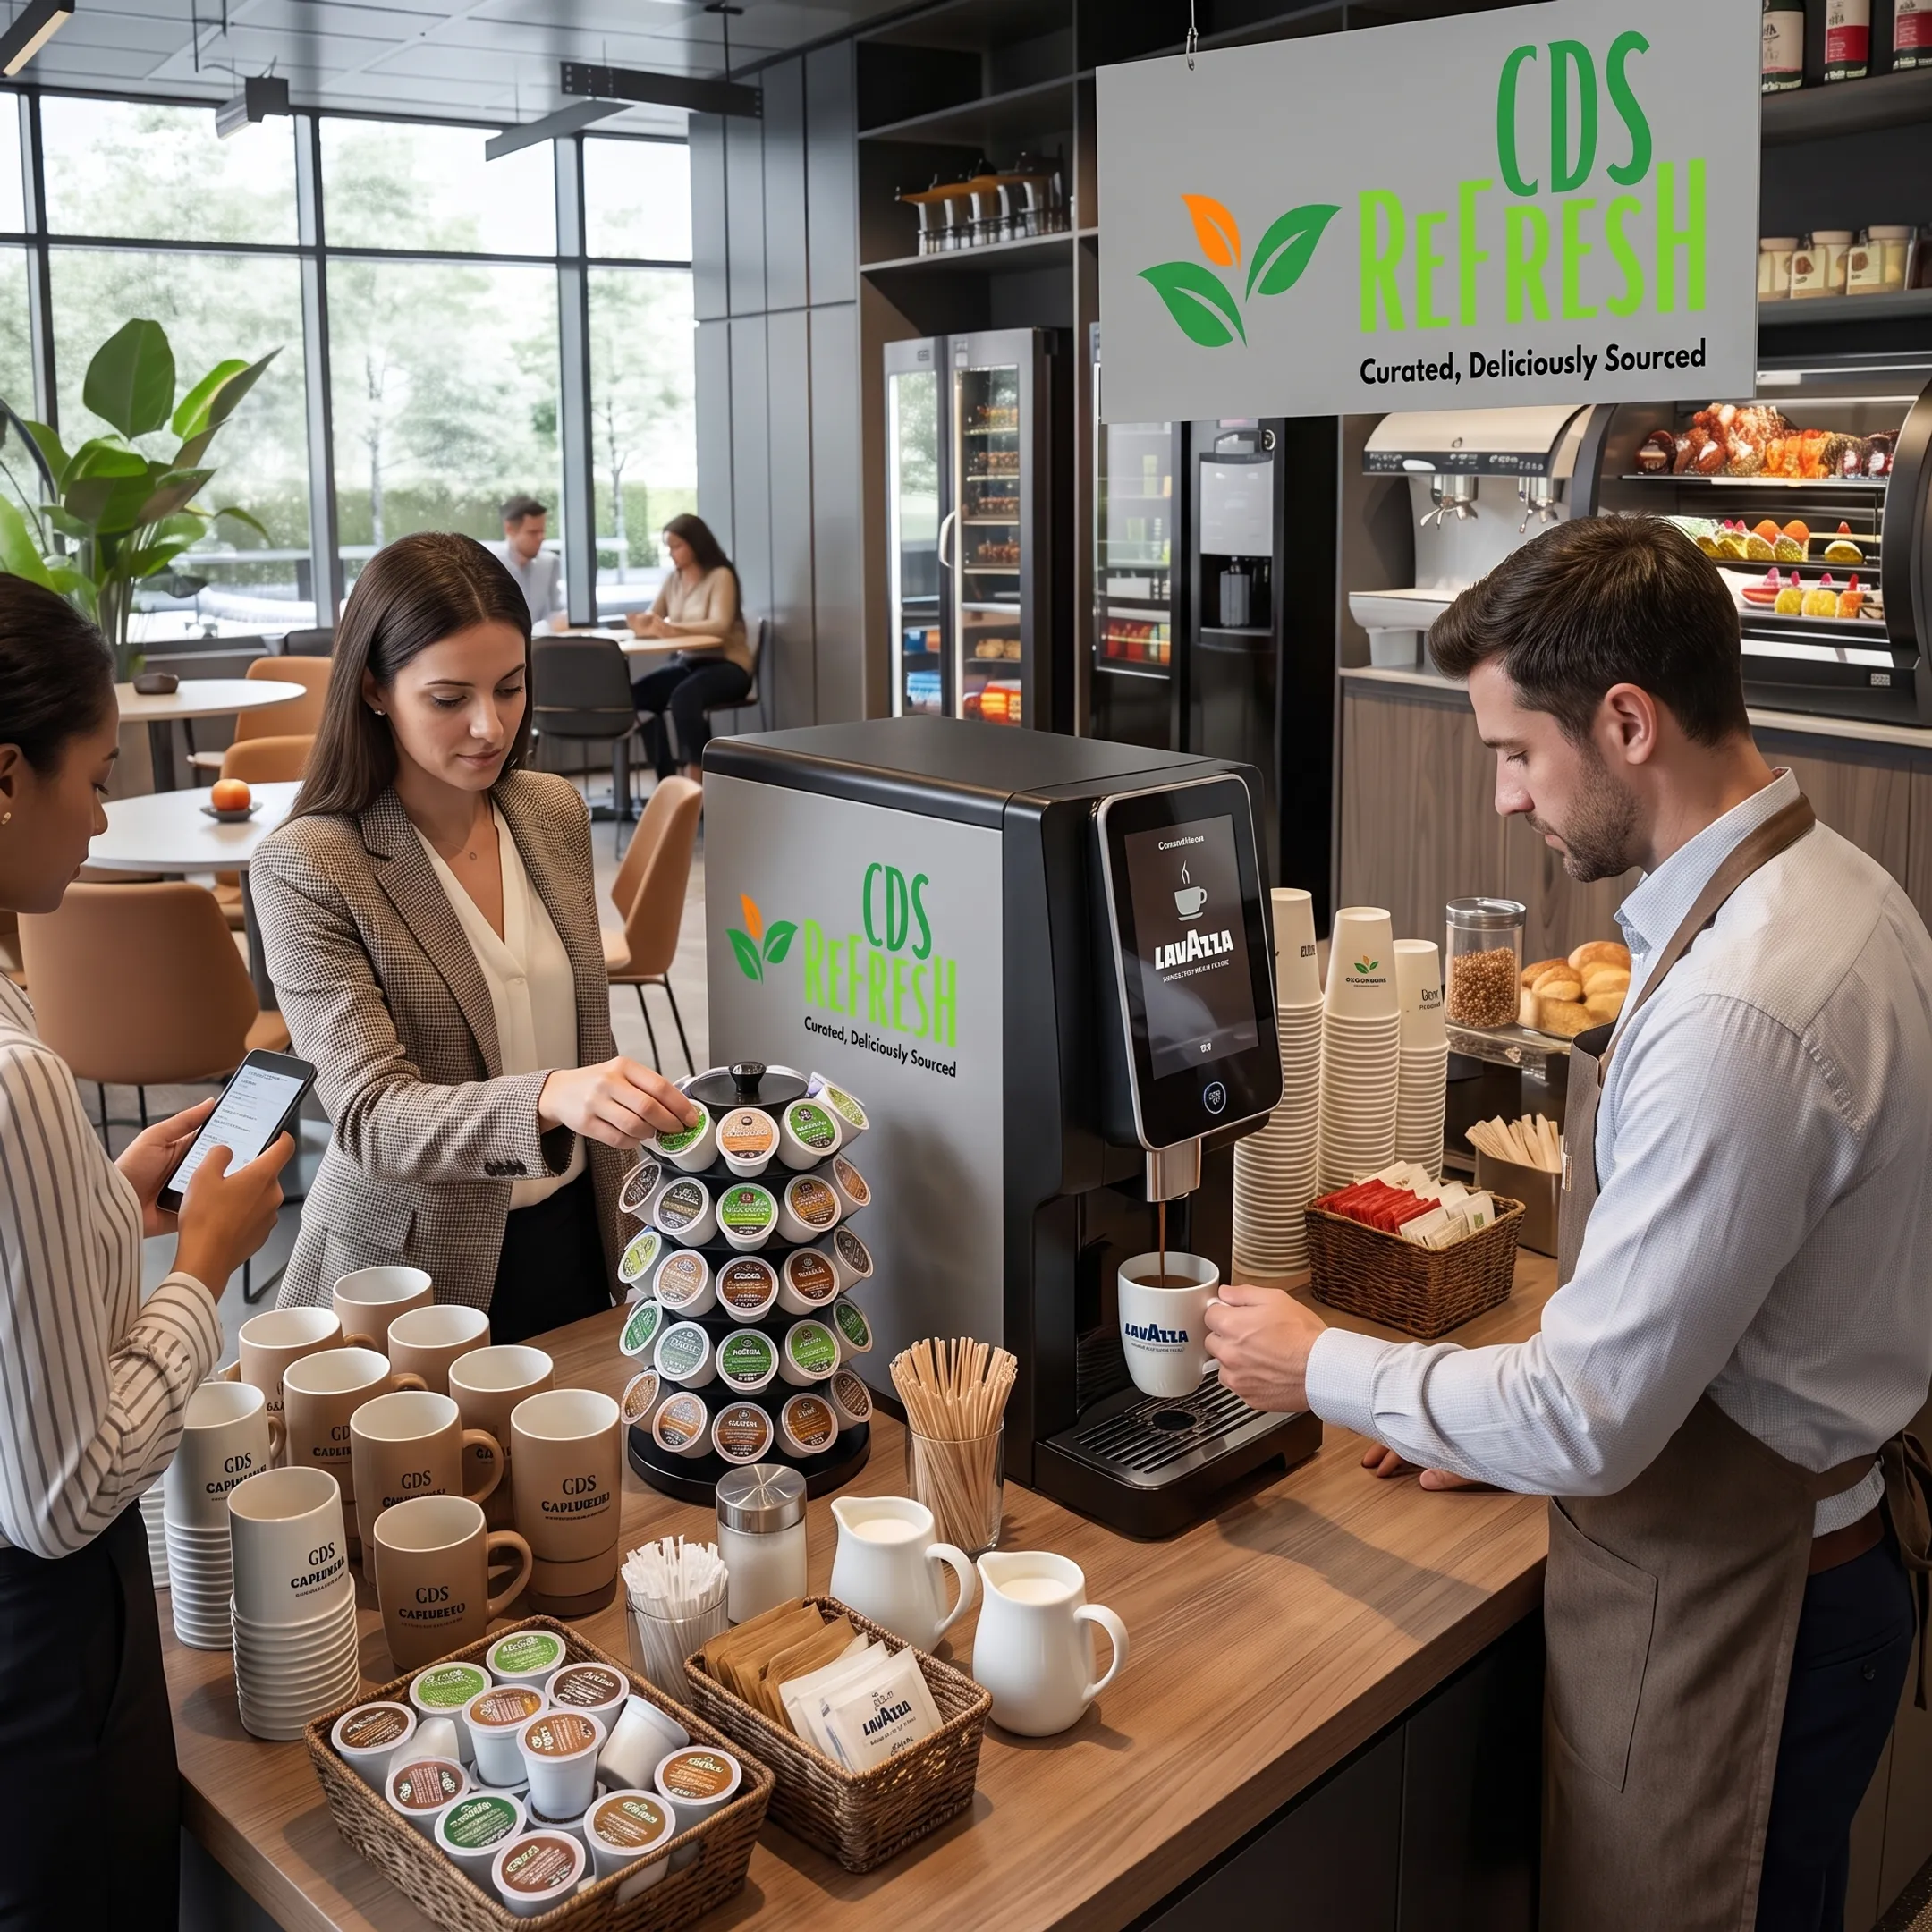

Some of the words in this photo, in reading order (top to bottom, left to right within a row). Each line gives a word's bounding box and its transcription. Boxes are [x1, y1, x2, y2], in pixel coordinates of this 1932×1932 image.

[1497, 30, 1652, 197] CDS
[1360, 352, 1462, 386] Curated,
[1470, 344, 1598, 381] Deliciously
[1605, 337, 1706, 372] Sourced
[862, 862, 932, 960] CDS
[1155, 928, 1234, 970] LAVAZZA
[804, 1015, 848, 1045] Curated,
[851, 1030, 909, 1065] Deliciously
[911, 1049, 957, 1078] Sourced
[1124, 1322, 1190, 1343] LAVAZZA
[224, 1452, 252, 1474] GDS
[401, 1470, 432, 1490] GDS
[562, 1474, 597, 1496] GDS
[308, 1541, 335, 1566] GDS
[415, 1585, 449, 1604] GDS
[862, 1699, 912, 1736] LAVAZZA
